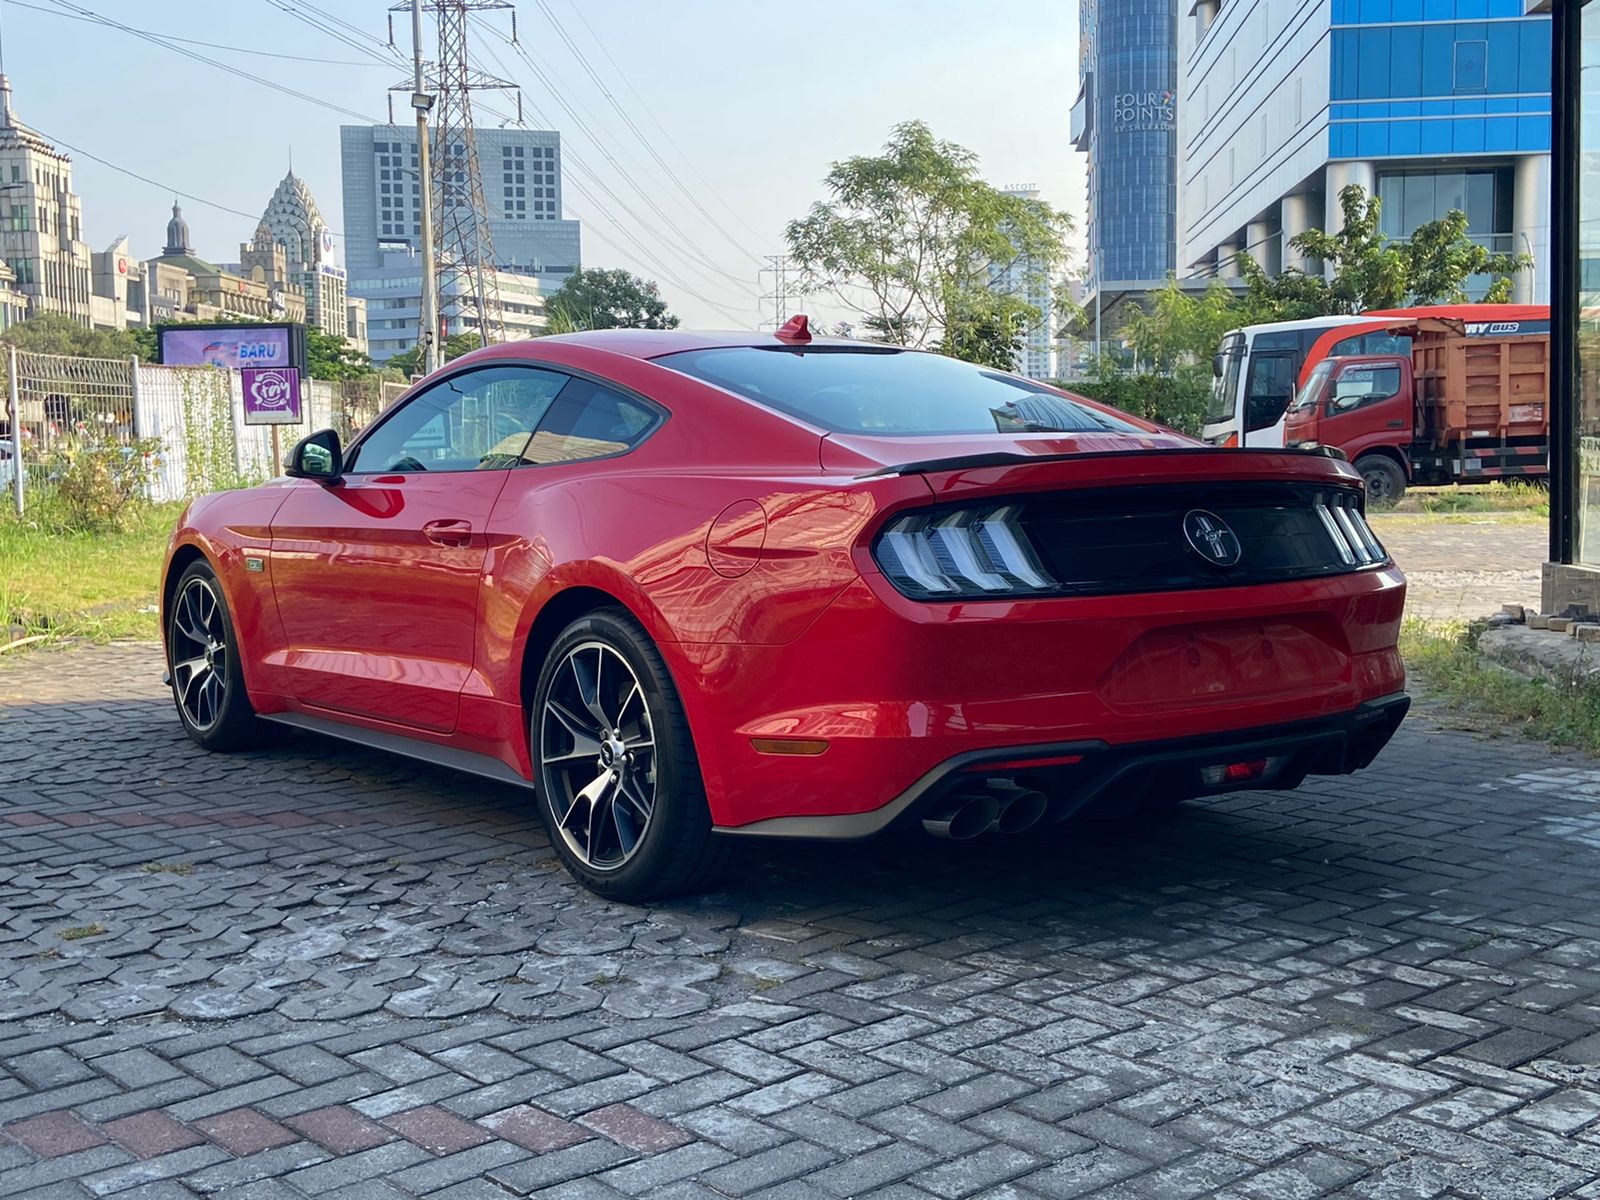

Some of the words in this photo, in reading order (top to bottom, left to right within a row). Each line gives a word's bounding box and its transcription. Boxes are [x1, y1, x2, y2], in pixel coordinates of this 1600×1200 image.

[1114, 92, 1157, 108] FOUR
[1114, 106, 1174, 122] POINTS
[1492, 322, 1518, 332] BUS
[240, 343, 277, 359] BARU
